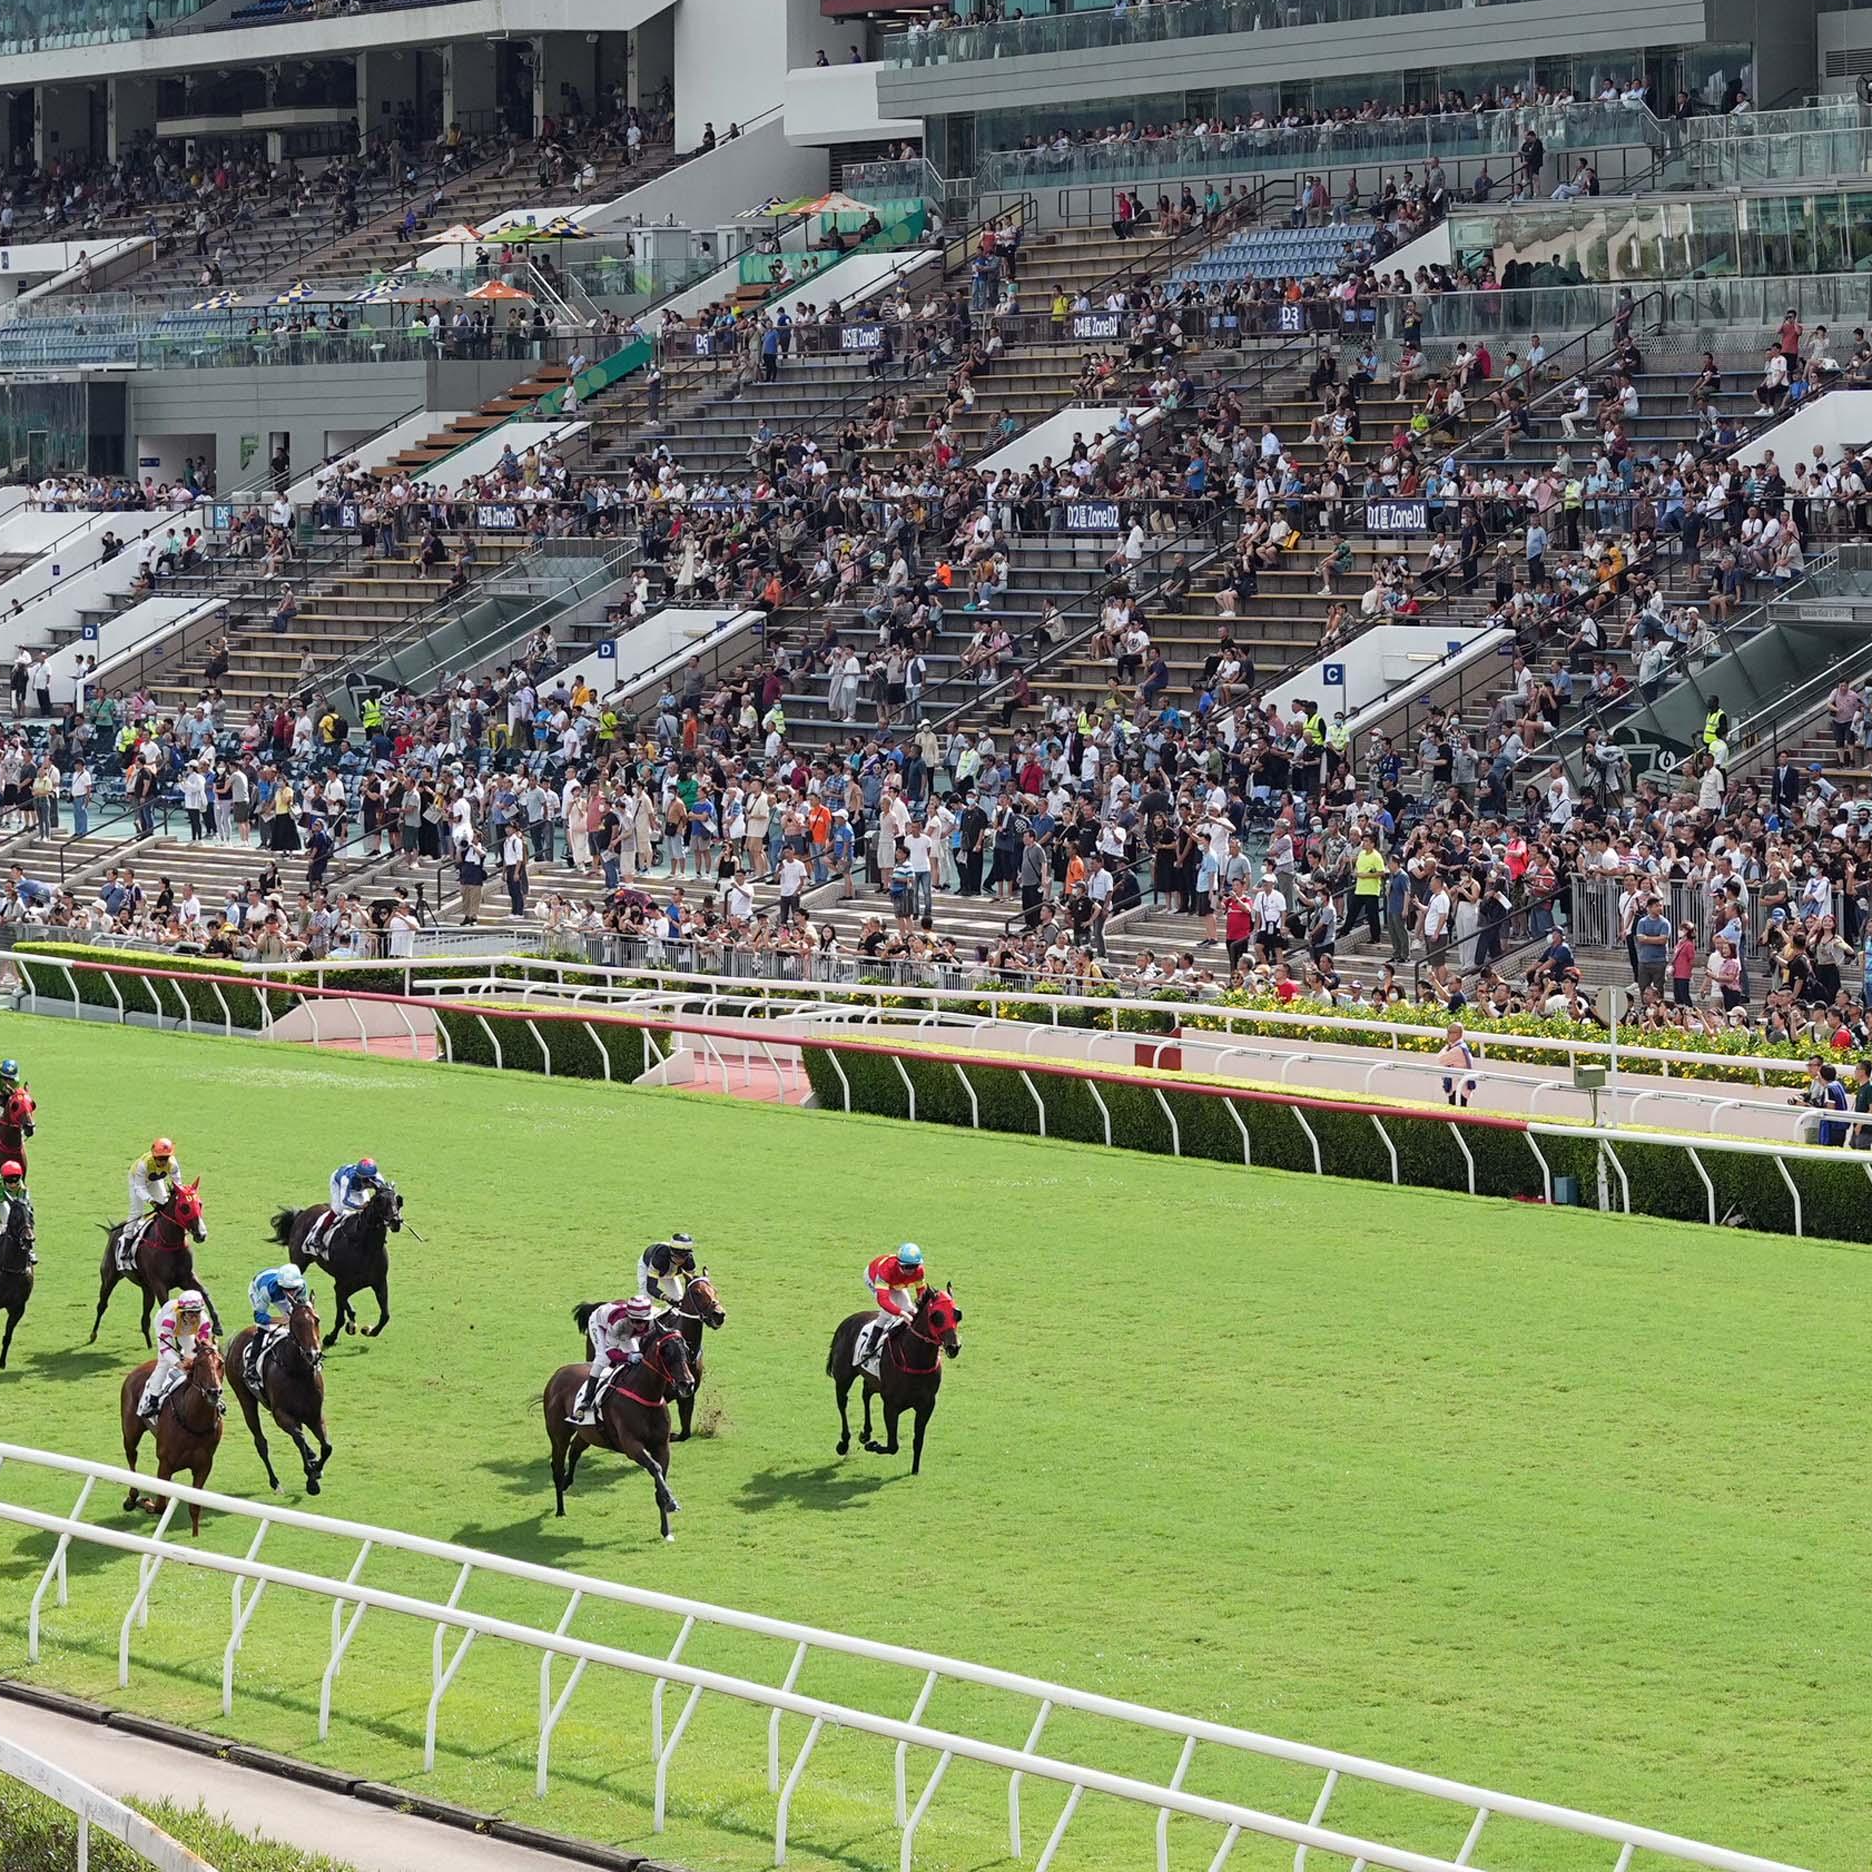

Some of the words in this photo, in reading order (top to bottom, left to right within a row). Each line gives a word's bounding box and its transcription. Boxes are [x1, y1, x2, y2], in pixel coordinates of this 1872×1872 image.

[1282, 306, 1299, 322] D3
[1067, 506, 1086, 527] D2區
[1088, 506, 1107, 527] Zone
[1108, 506, 1119, 527] D2
[1367, 505, 1388, 529] D1區
[1390, 505, 1413, 529] Zone
[1413, 505, 1426, 529] D1
[85, 628, 94, 637] D
[601, 644, 611, 656] D
[1327, 668, 1338, 681] C
